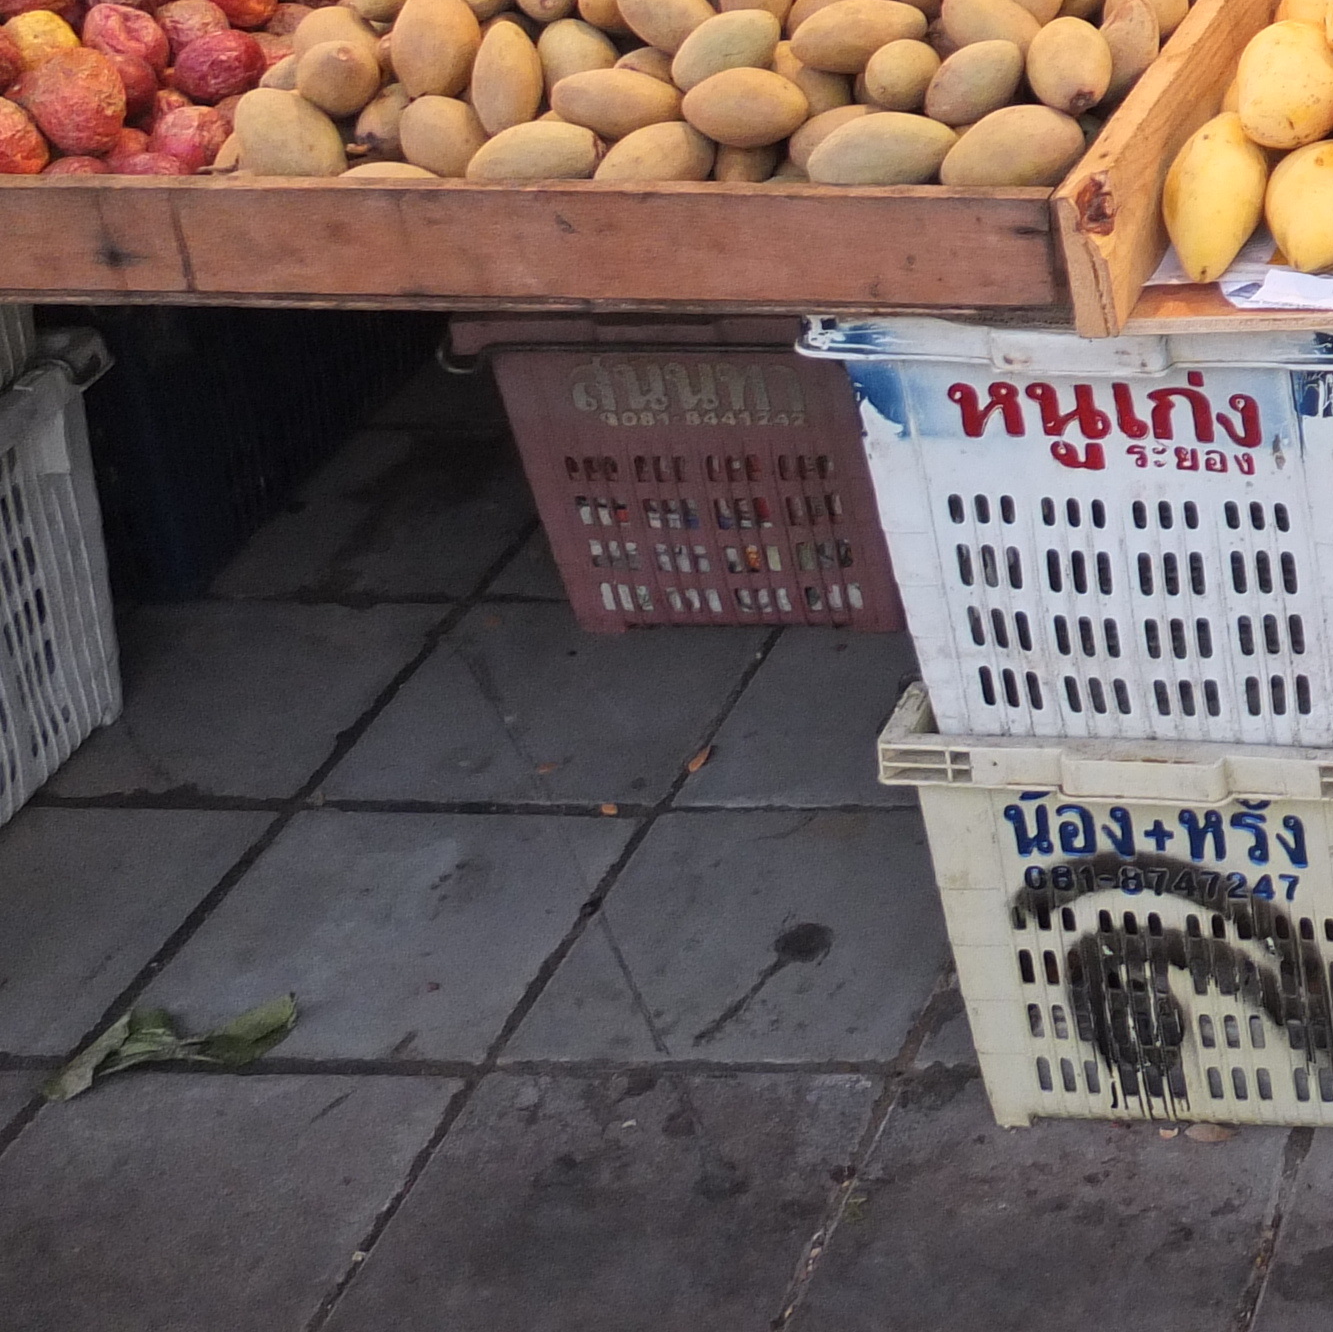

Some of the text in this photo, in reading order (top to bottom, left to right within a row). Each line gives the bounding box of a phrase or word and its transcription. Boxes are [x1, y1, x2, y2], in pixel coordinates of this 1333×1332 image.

[947, 370, 1264, 470] หนูเก่ง
[1126, 444, 1256, 475] ระยอง
[1025, 865, 1300, 902] 081-8747247
